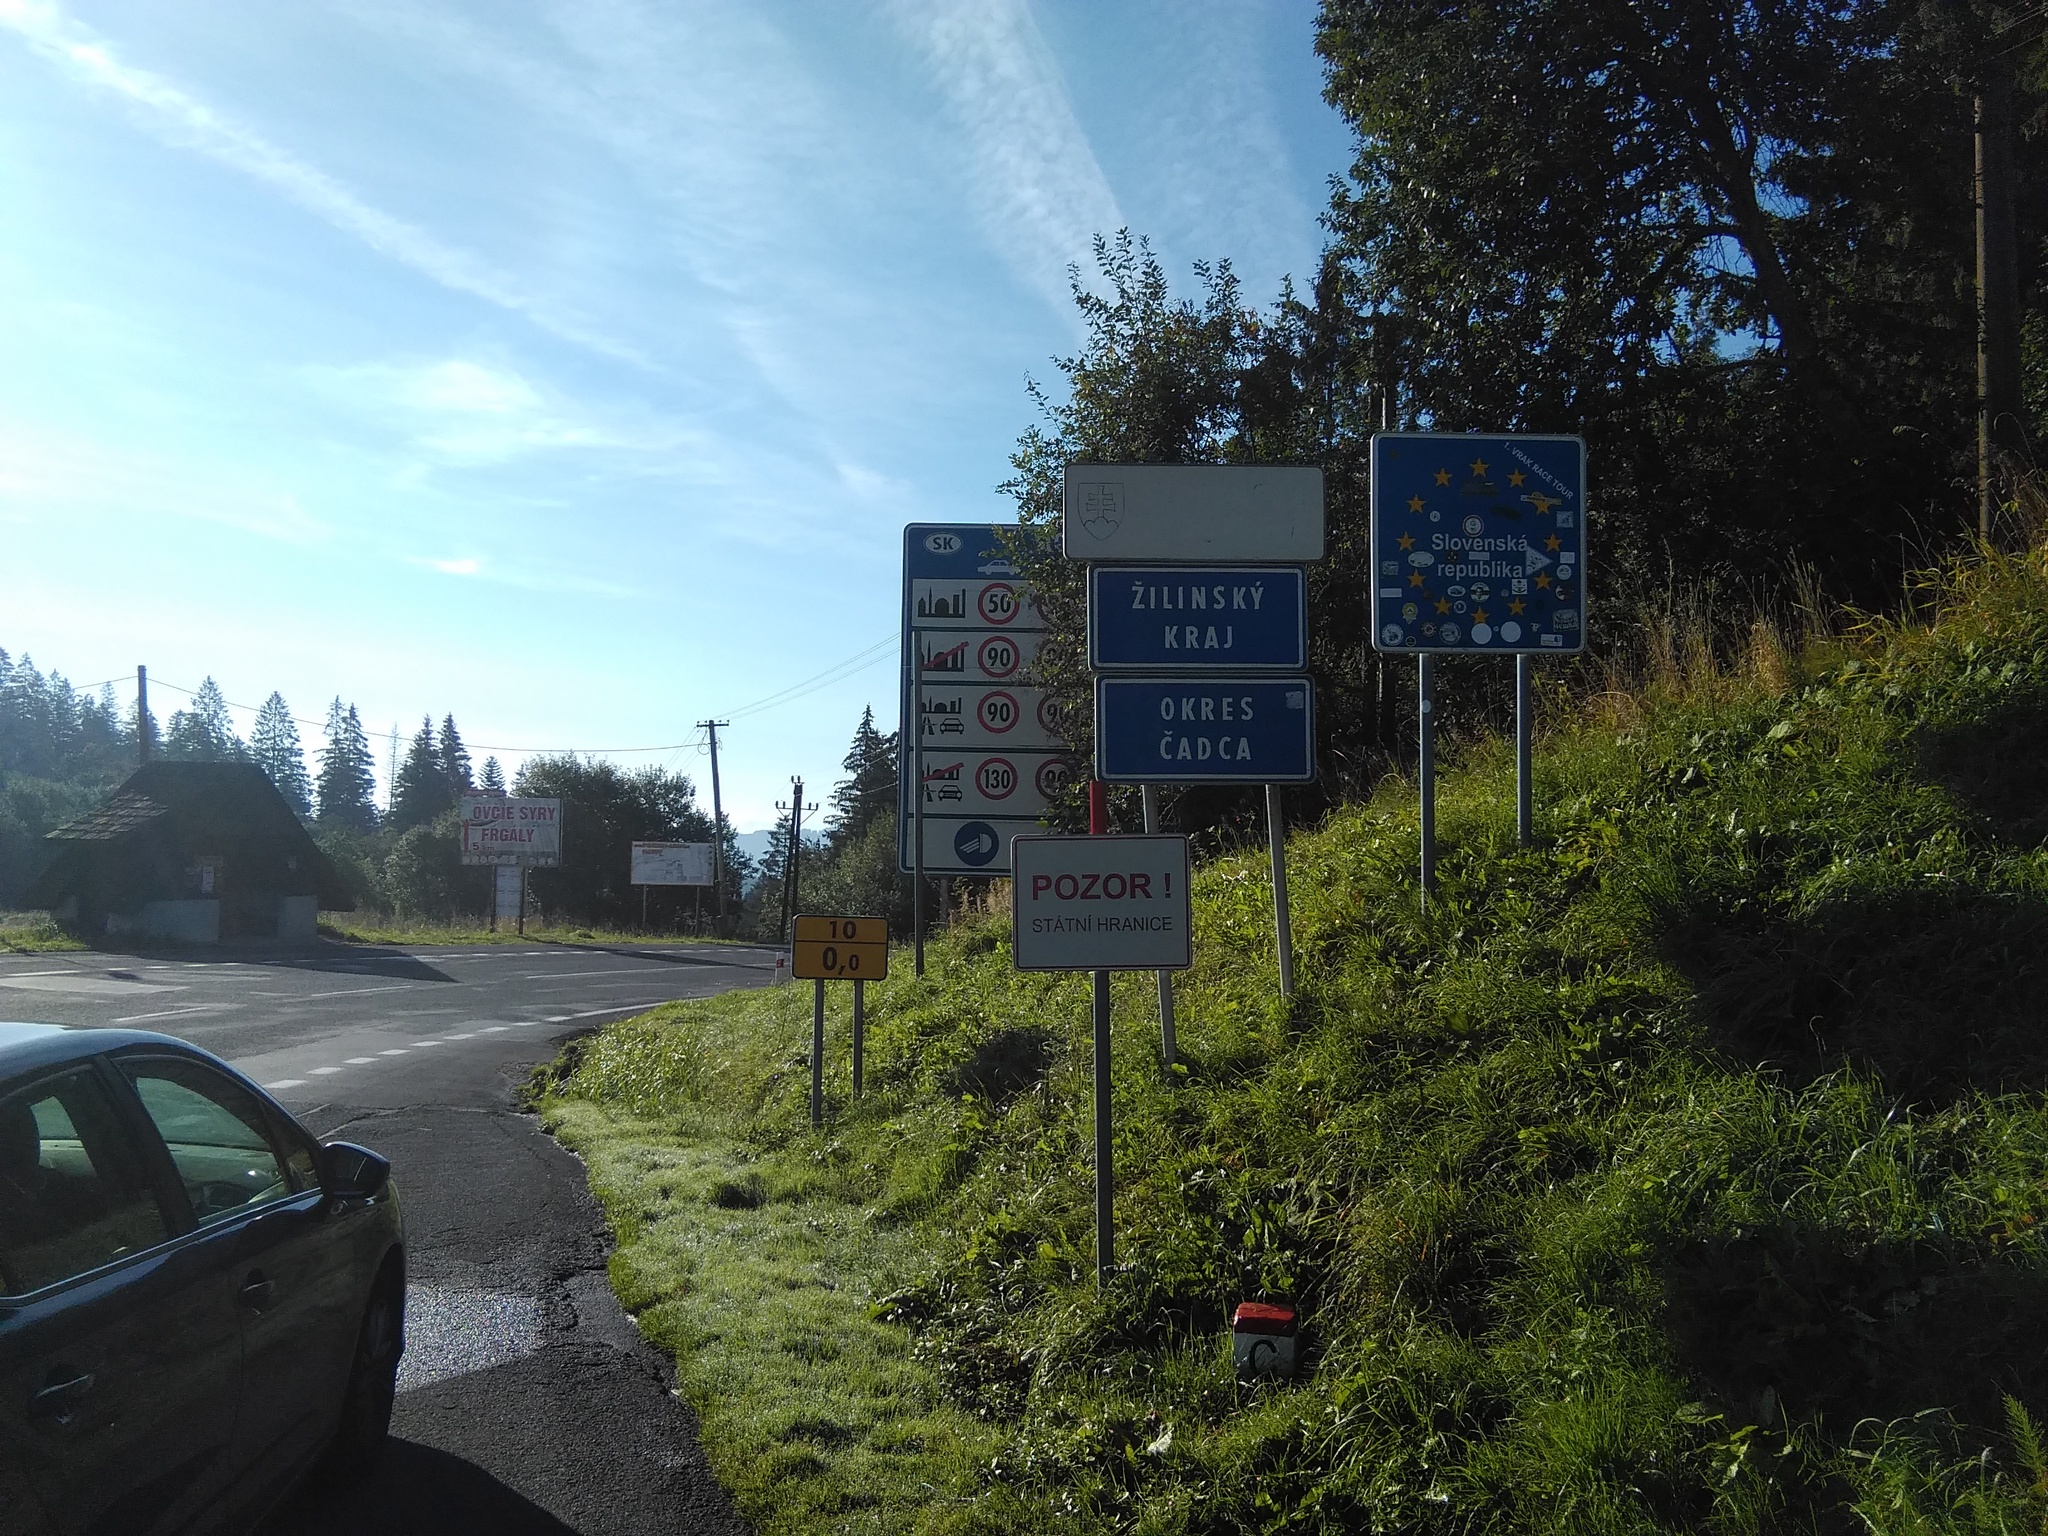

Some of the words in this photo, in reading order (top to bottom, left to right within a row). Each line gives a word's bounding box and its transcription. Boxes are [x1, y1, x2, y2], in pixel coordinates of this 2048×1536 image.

[1511, 447, 1533, 467] VRAK
[1531, 464, 1554, 483] RACE
[1552, 479, 1574, 500] TOUR
[932, 536, 954, 550] SK
[1431, 533, 1528, 551] Slovenská
[1437, 561, 1523, 581] republika
[988, 593, 1011, 614] 50
[1132, 580, 1265, 610] ŽILINSKÝ
[1164, 625, 1234, 649] KRAJ
[987, 647, 1011, 668] 90
[987, 702, 1011, 722] 90
[1160, 697, 1255, 721] OKRES
[1159, 730, 1252, 761] ČADCA
[984, 768, 1011, 790] 130
[473, 802, 514, 820] OVČIE
[519, 805, 555, 820] SYRY
[481, 825, 535, 842] FRGÁLY
[473, 842, 480, 851] 5
[1032, 873, 1153, 900] POZOR
[829, 920, 857, 940] 10
[1032, 914, 1093, 933] STÁTNÍ
[1098, 916, 1173, 932] HRANICE
[822, 946, 860, 976] 0,0
